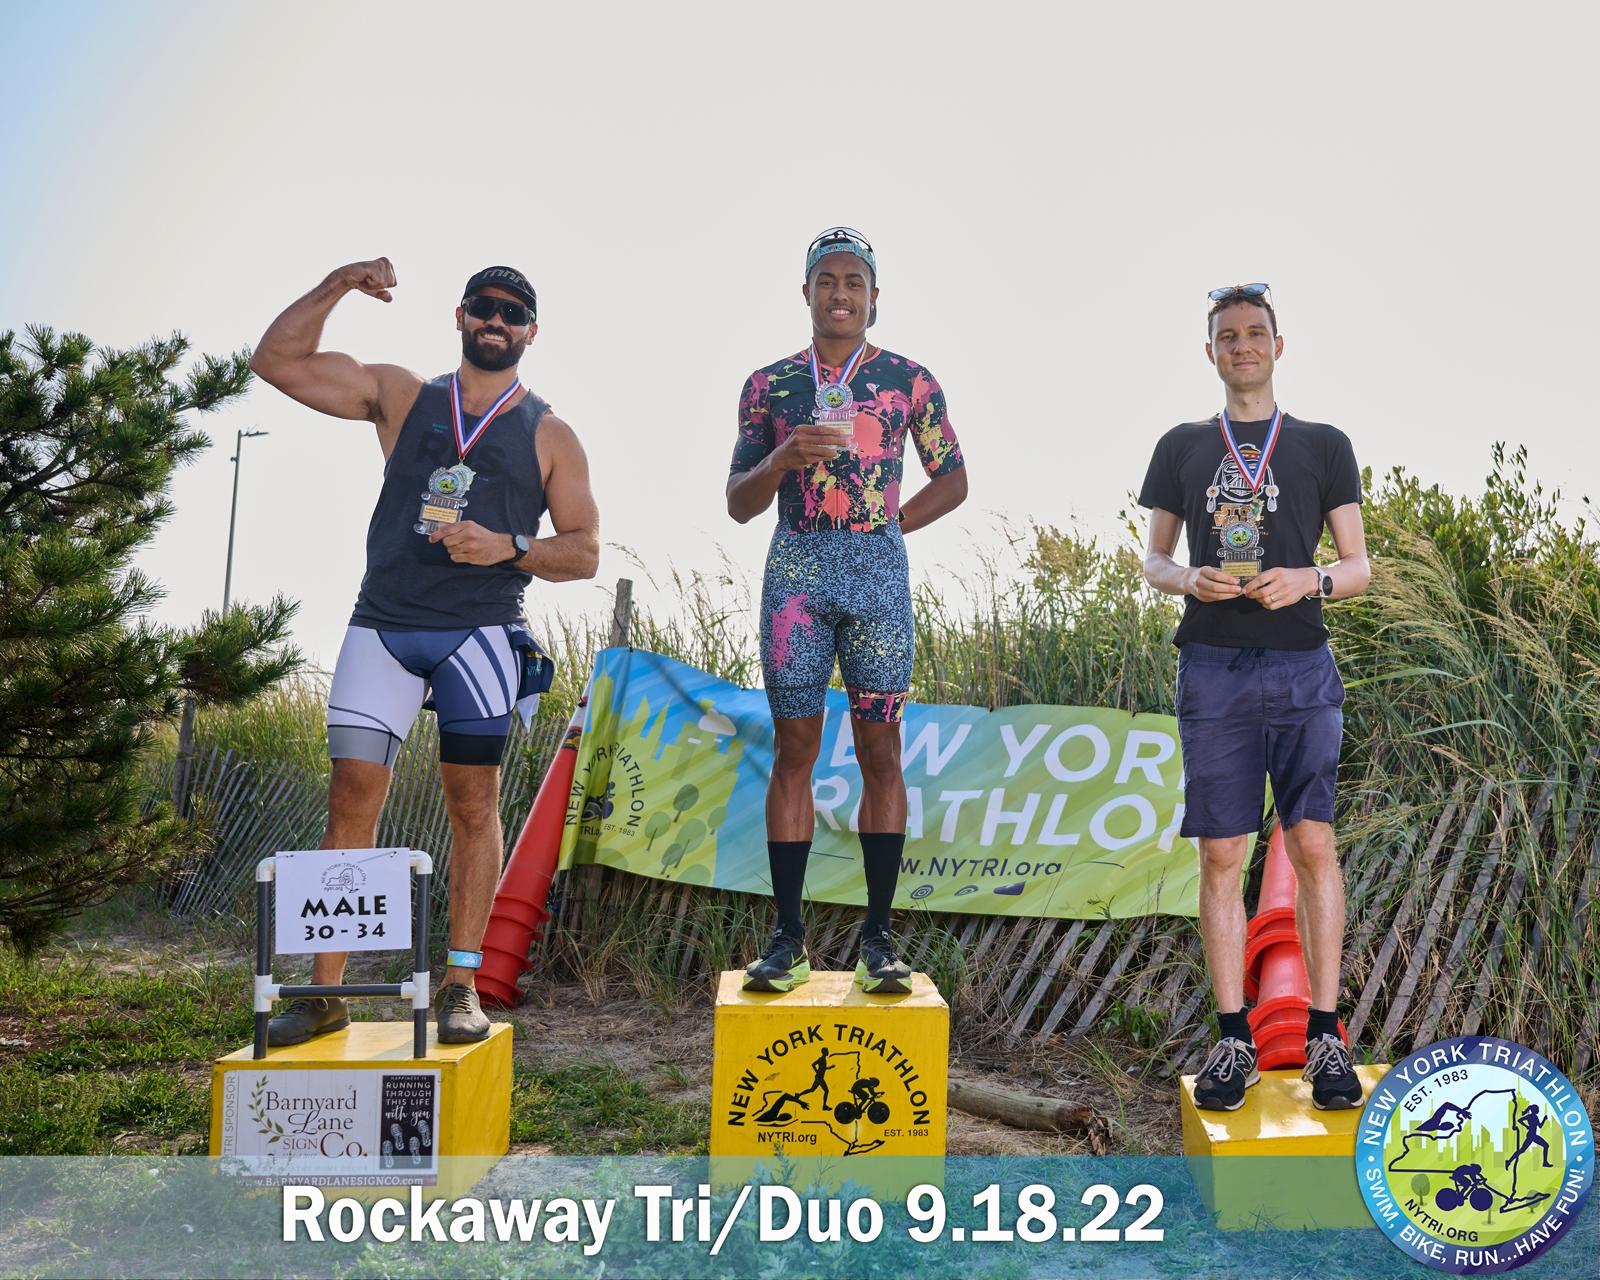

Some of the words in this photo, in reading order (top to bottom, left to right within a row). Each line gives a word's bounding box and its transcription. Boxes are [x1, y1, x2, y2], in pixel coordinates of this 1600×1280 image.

[414, 431, 506, 477] RS
[822, 706, 973, 776] EW
[999, 724, 1185, 791] YOR
[565, 780, 586, 826] NEW
[613, 742, 645, 827] RIATHLON
[604, 823, 617, 832] EST.
[619, 827, 635, 837] 1983
[327, 863, 342, 871] YORK
[343, 862, 367, 882] TRIATHLON
[300, 895, 387, 918] MALE
[305, 925, 335, 941] 30
[358, 922, 385, 939] 34
[728, 1069, 759, 1127] NEW
[757, 1024, 825, 1066] YORK
[833, 1023, 930, 1126] TRIATHLON
[225, 1076, 236, 1132] SPONSOR
[266, 1090, 357, 1113] Barnyard
[386, 1098, 407, 1106] THIS
[410, 1098, 430, 1106] LIFE
[288, 1110, 353, 1136] Lane
[385, 1105, 408, 1121] with
[410, 1109, 431, 1126] you
[758, 1131, 817, 1145] NYTRI.org
[884, 1129, 904, 1137] EST.
[908, 1129, 929, 1137] 1983
[283, 1138, 318, 1150] SIGN
[320, 1132, 368, 1159] Co.
